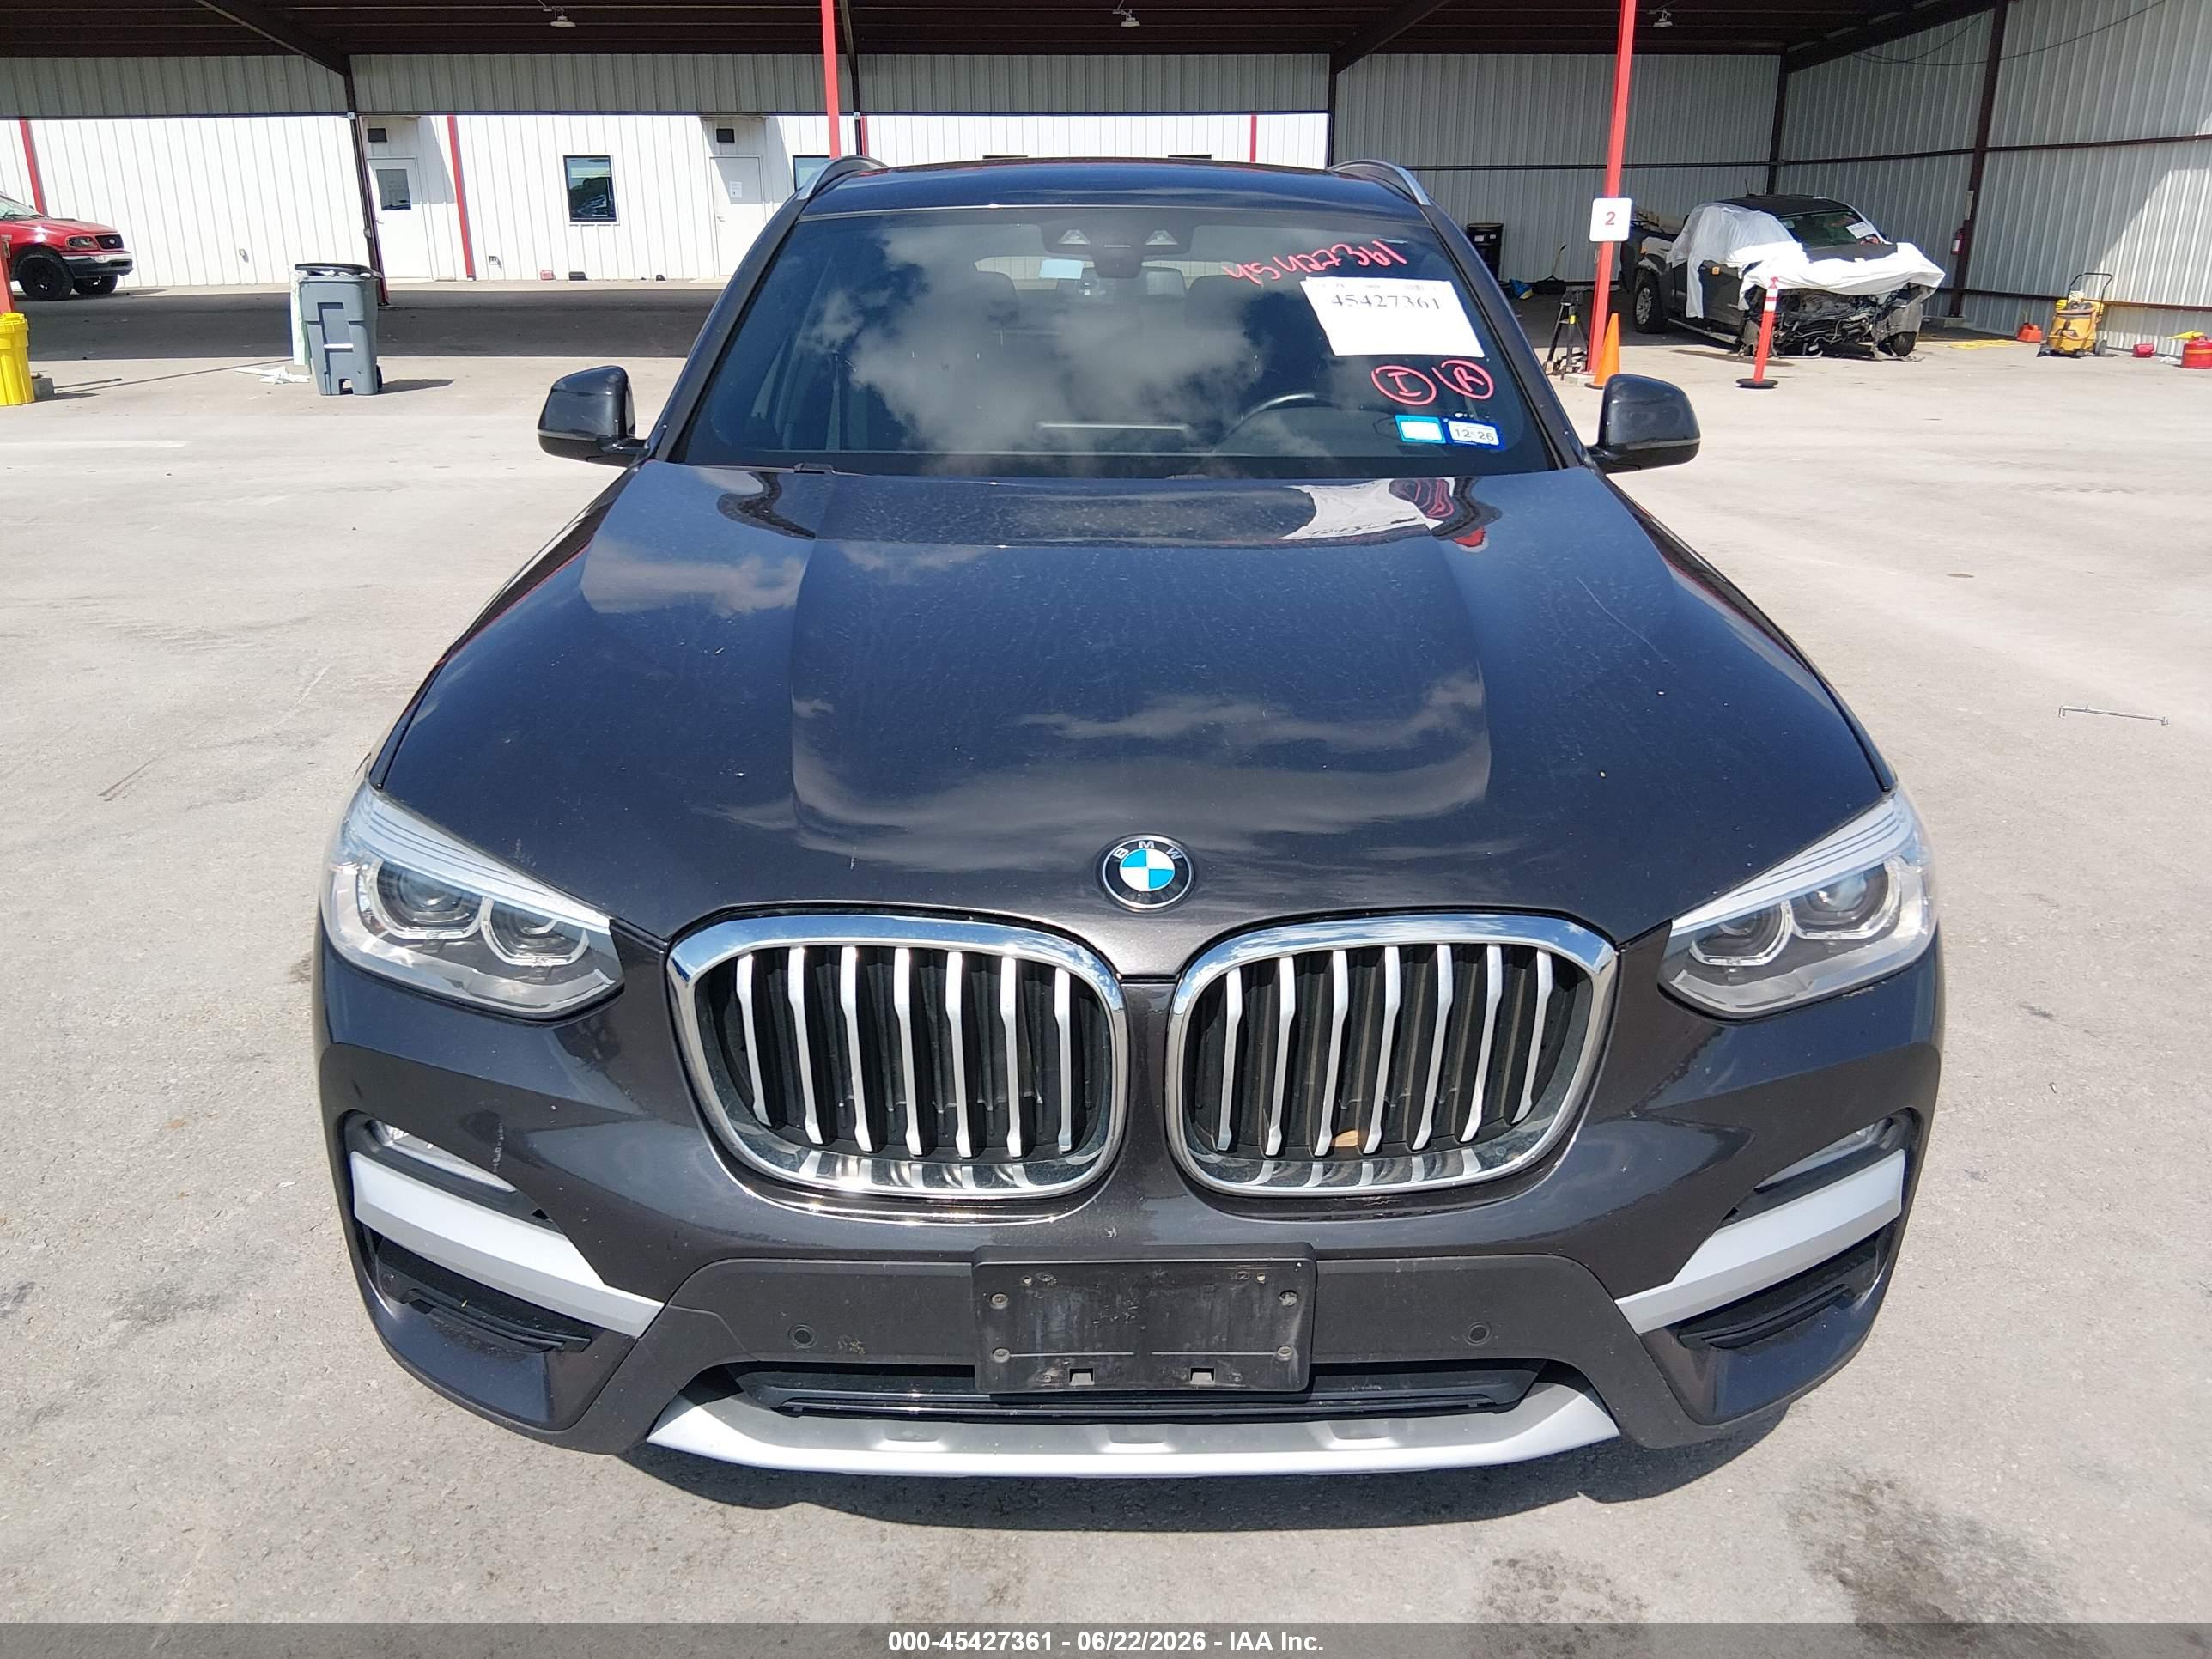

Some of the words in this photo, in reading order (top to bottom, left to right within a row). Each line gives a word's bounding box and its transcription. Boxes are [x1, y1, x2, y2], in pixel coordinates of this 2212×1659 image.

[1605, 211, 1616, 226] 2
[1331, 294, 1440, 310] 45427361
[1113, 840, 1182, 860] BMW
